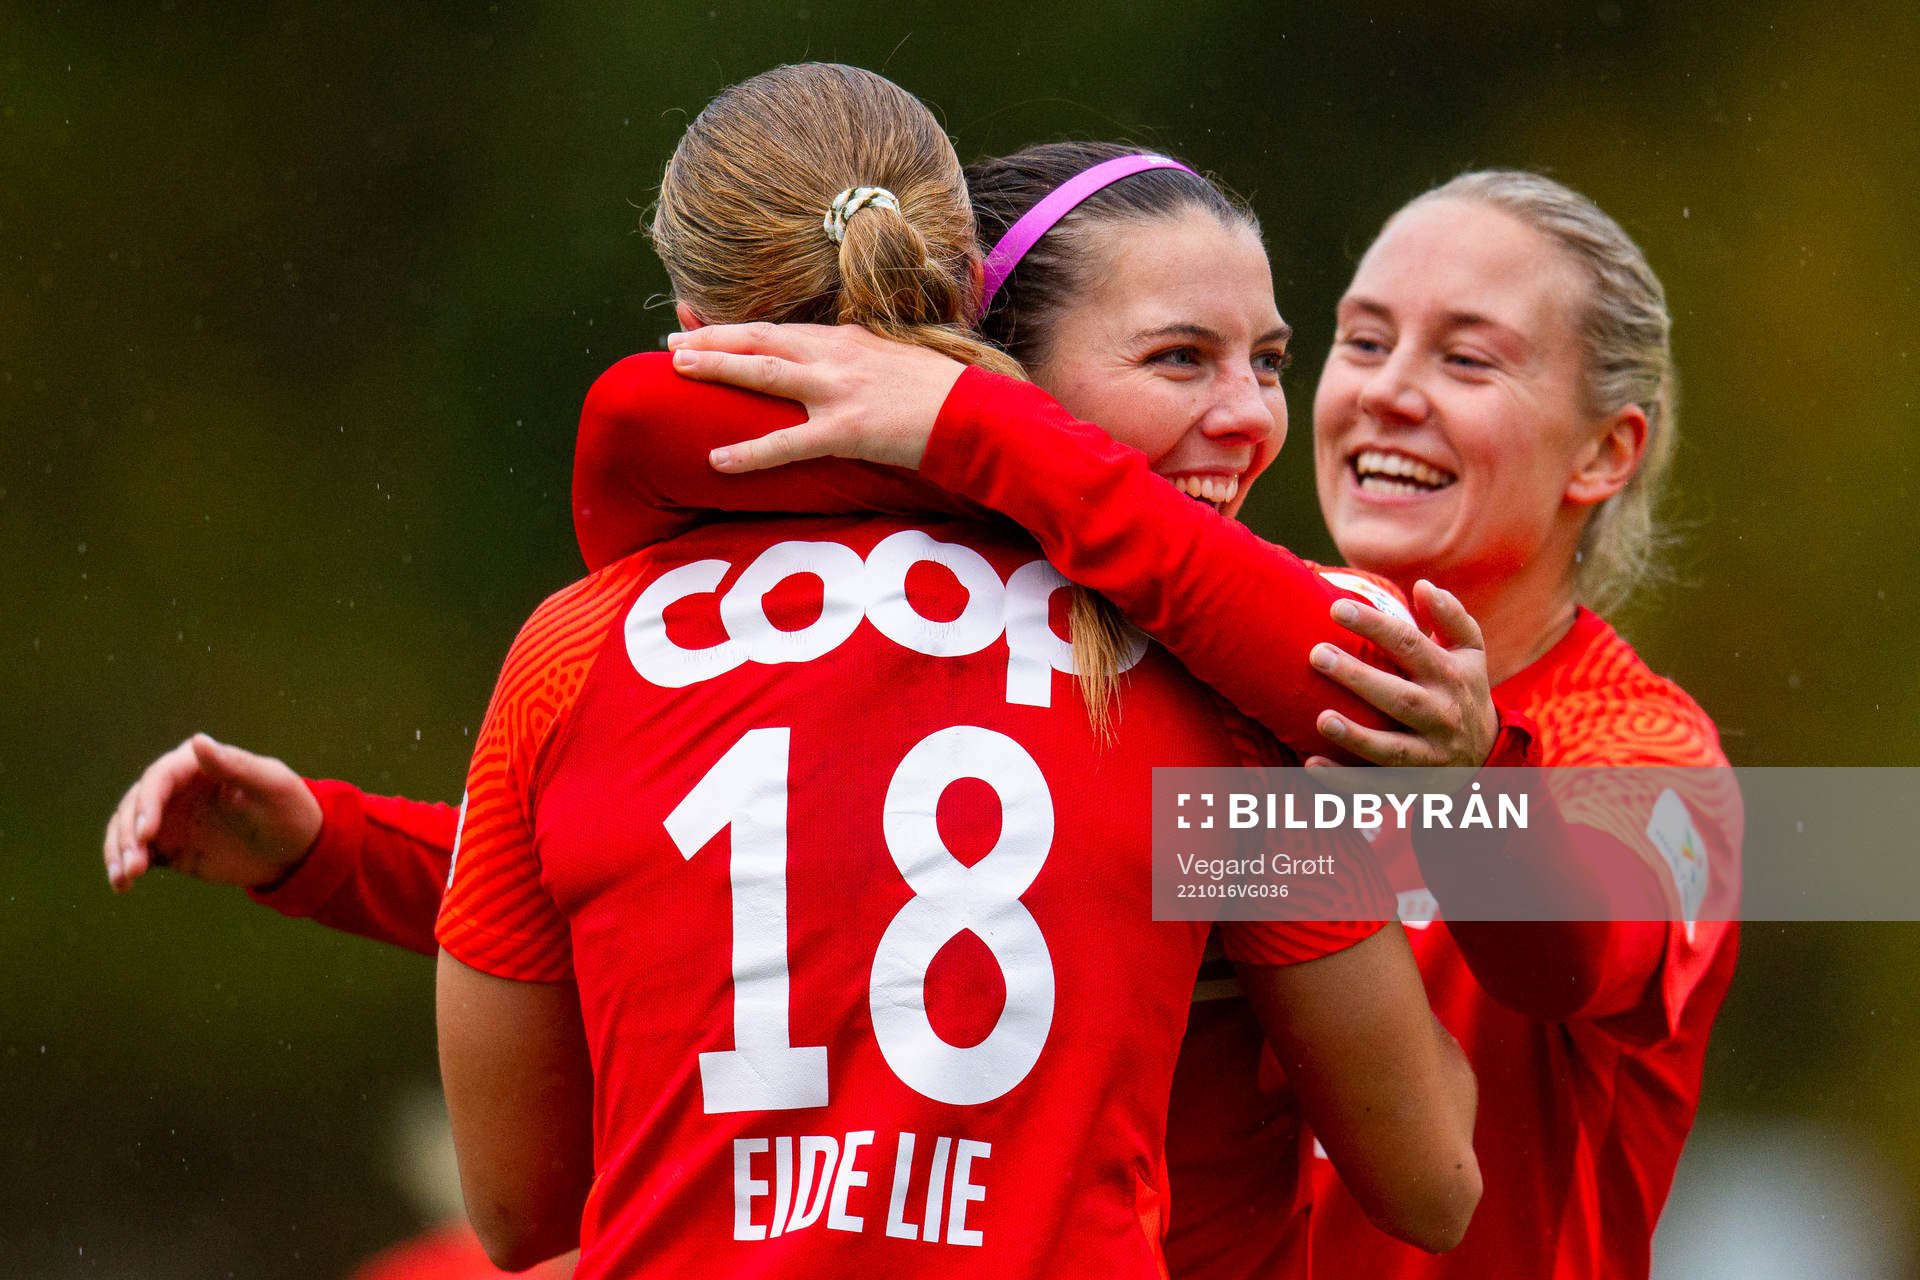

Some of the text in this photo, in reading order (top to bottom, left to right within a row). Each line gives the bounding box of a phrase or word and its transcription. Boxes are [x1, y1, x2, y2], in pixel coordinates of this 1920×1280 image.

[624, 530, 1148, 708] coop
[663, 725, 1055, 1114] 18
[733, 1130, 992, 1247] EIDE LIE
